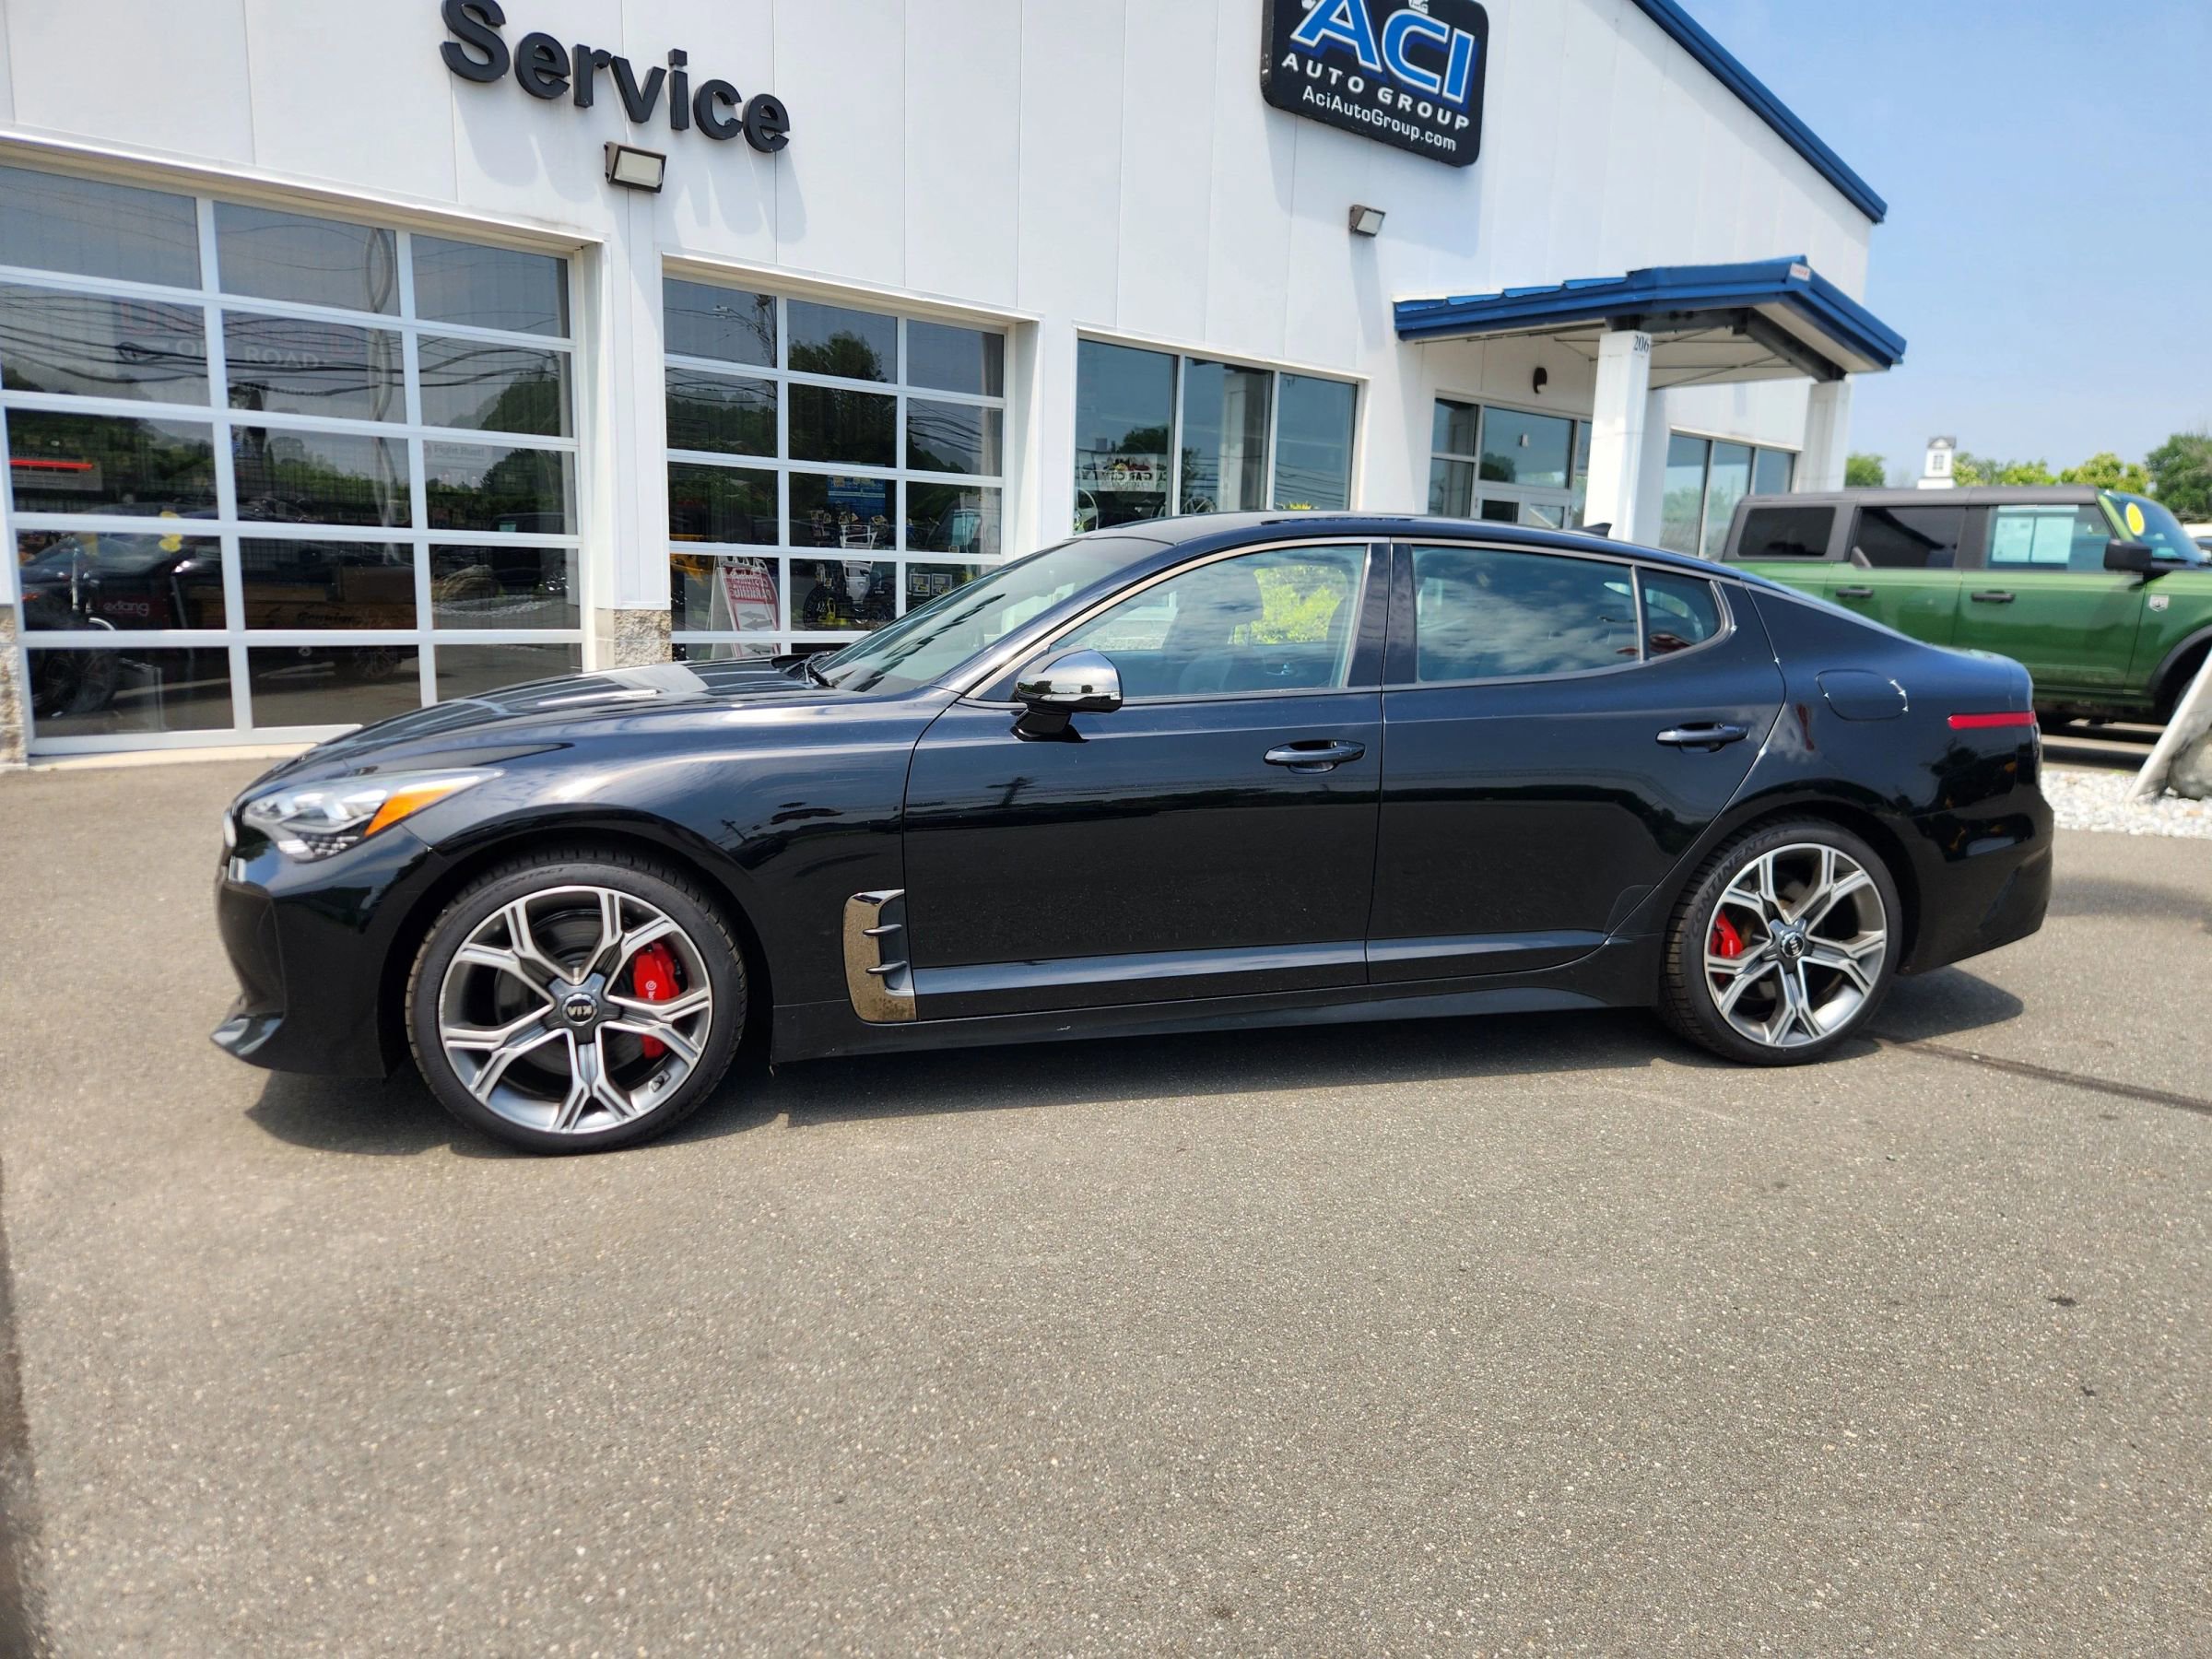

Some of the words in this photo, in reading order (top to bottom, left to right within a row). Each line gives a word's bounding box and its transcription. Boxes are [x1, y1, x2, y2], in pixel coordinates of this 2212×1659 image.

[440, 0, 790, 153] Service
[1289, 0, 1475, 104] ACI
[1281, 53, 1365, 93] AUTO
[1377, 87, 1470, 130] GROUP
[1302, 86, 1456, 151] AciAutoGroup.com
[1634, 335, 1650, 354] 206
